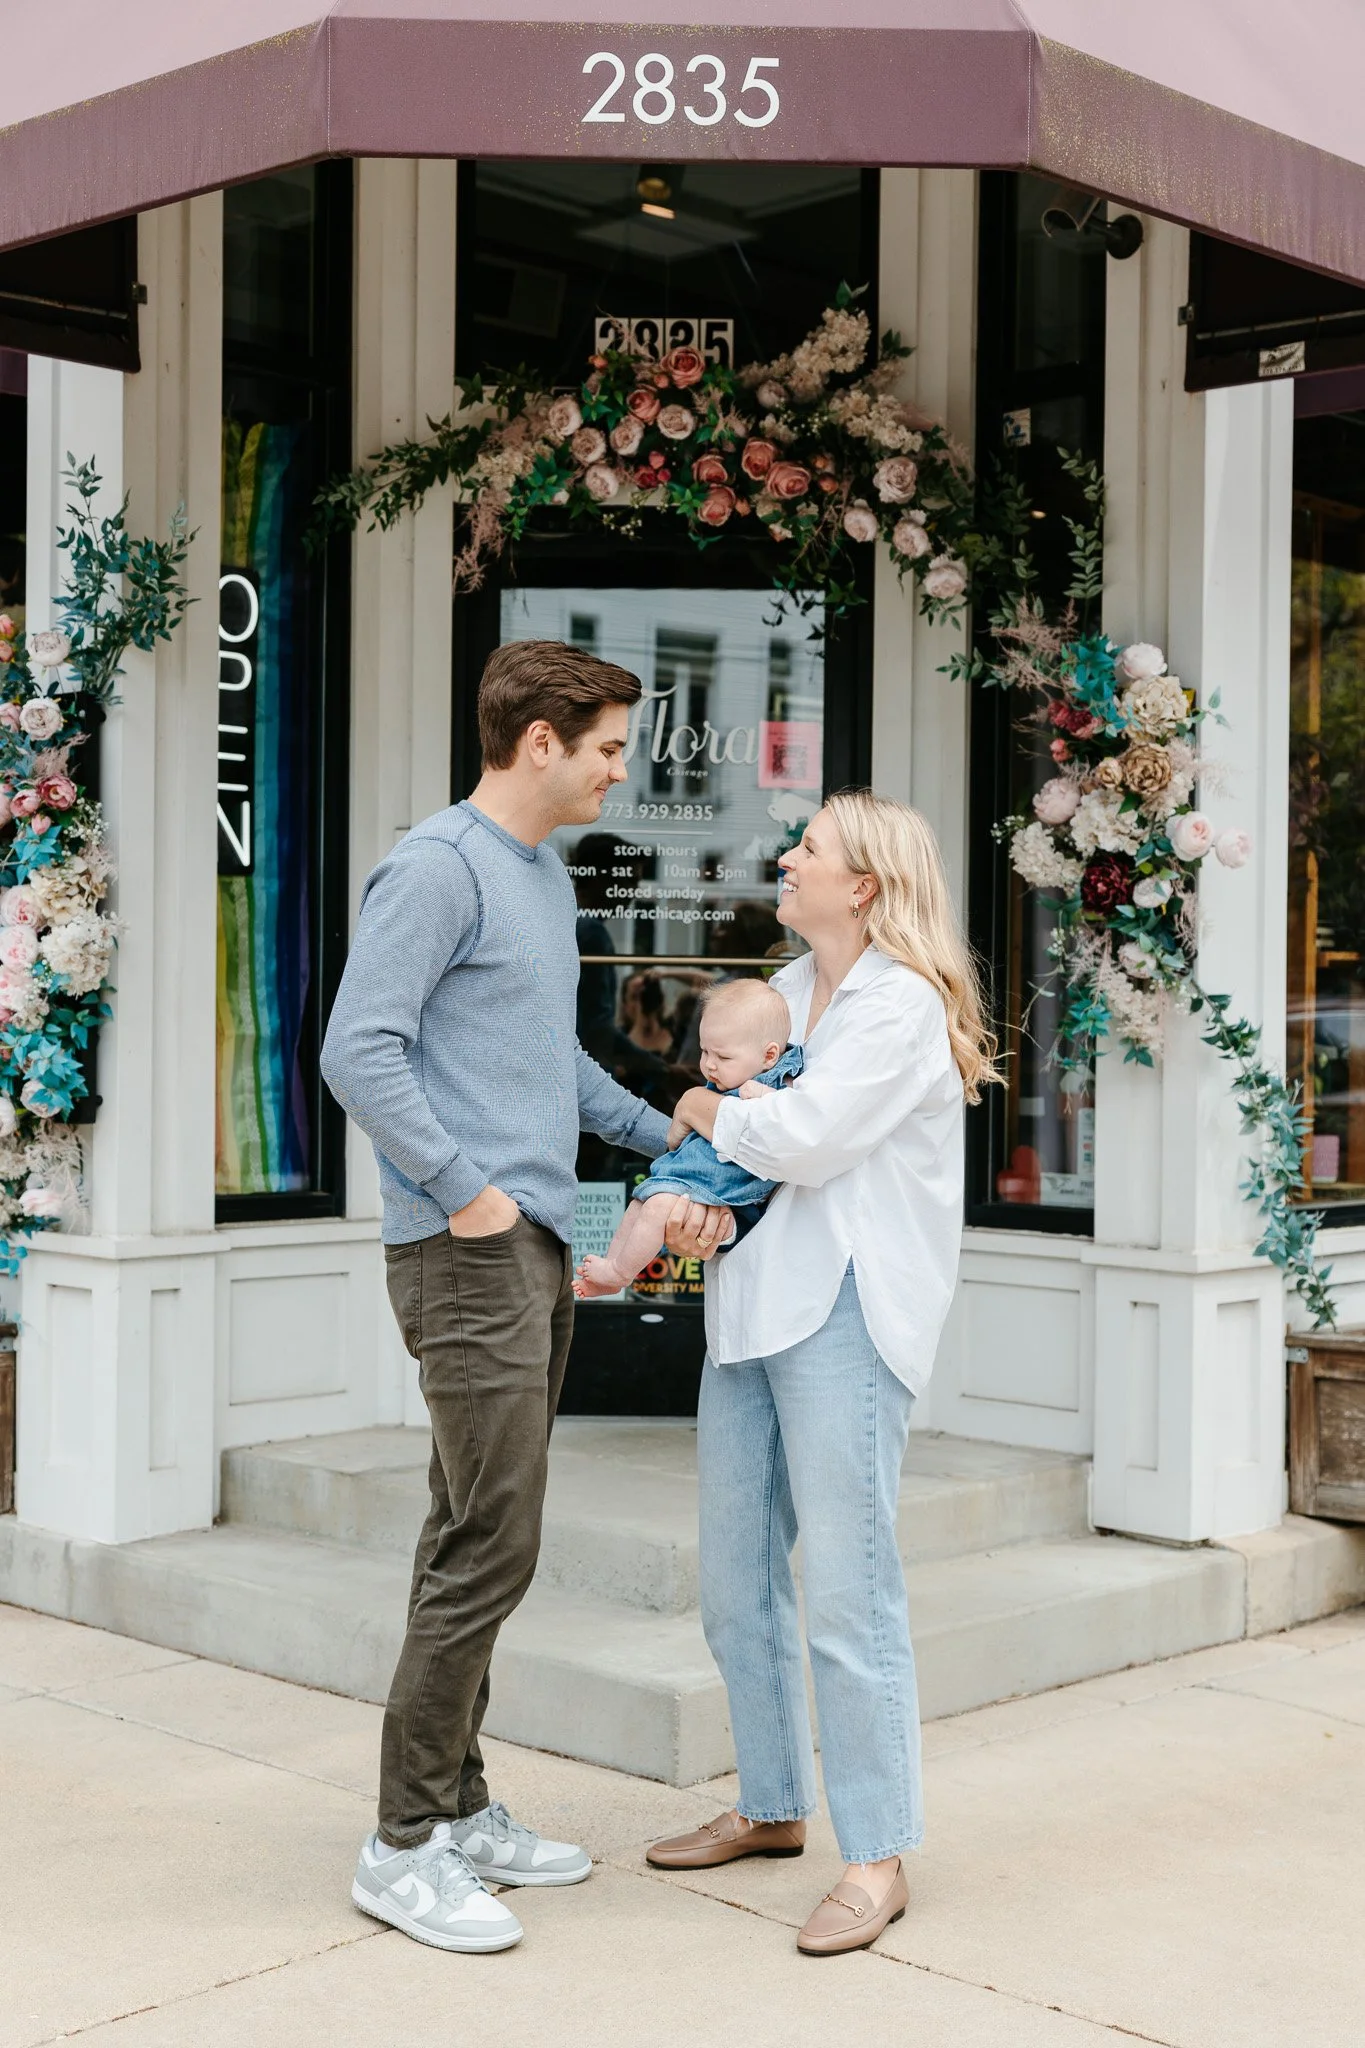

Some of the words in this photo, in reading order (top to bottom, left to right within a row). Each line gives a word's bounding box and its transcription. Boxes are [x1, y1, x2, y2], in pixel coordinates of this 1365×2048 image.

[581, 52, 780, 128] 2835
[622, 685, 760, 766] Flora
[666, 766, 709, 778] Chicago
[605, 803, 714, 821] 773.929.2835
[613, 844, 652, 857] store
[656, 843, 698, 858] hours
[565, 865, 597, 877] mon
[611, 865, 634, 878] sat
[664, 864, 700, 878] 10am
[716, 865, 747, 882] 5pm
[605, 884, 651, 899] closed
[656, 886, 705, 903] sunday
[577, 905, 735, 924] www.florachicago.com
[578, 1194, 621, 1204] MERICA
[586, 1242, 610, 1251] WIT
